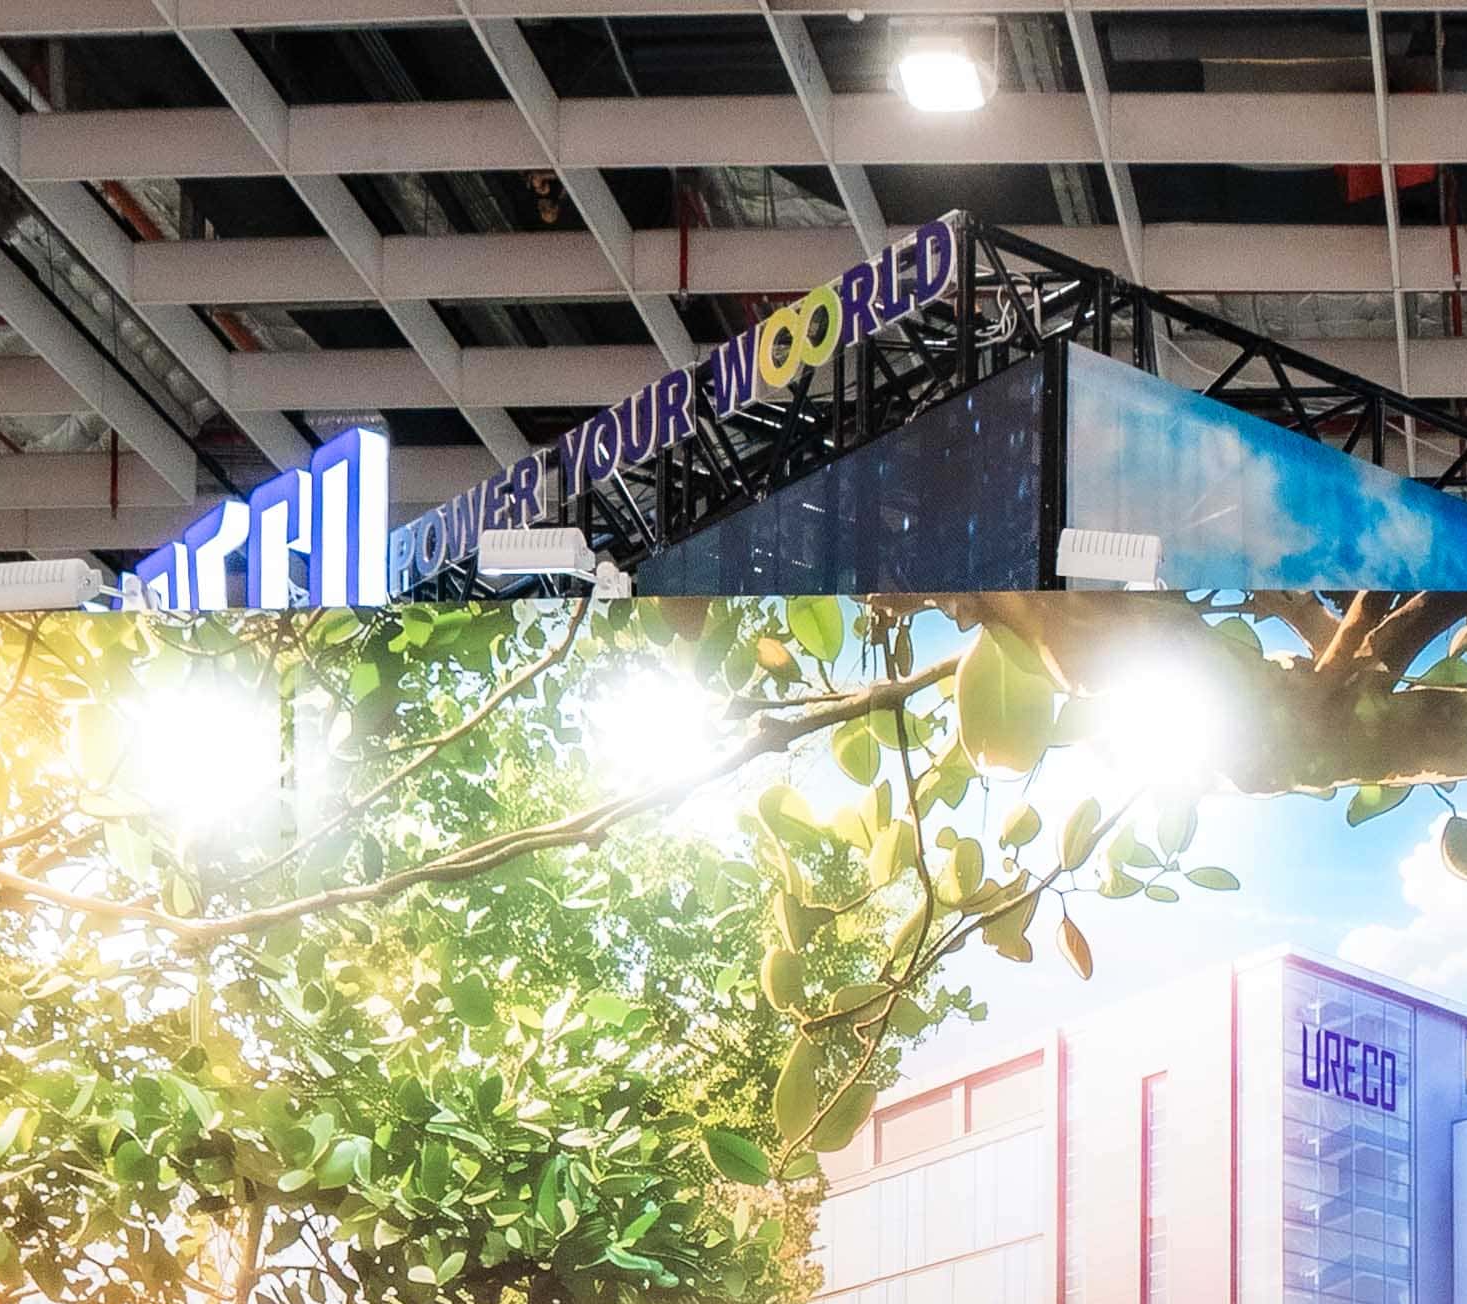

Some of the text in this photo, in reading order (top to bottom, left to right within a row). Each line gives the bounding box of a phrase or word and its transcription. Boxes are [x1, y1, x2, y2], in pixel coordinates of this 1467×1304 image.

[389, 453, 546, 592] POWER
[559, 368, 695, 496] YOUR
[1302, 1021, 1396, 1113] URECO
